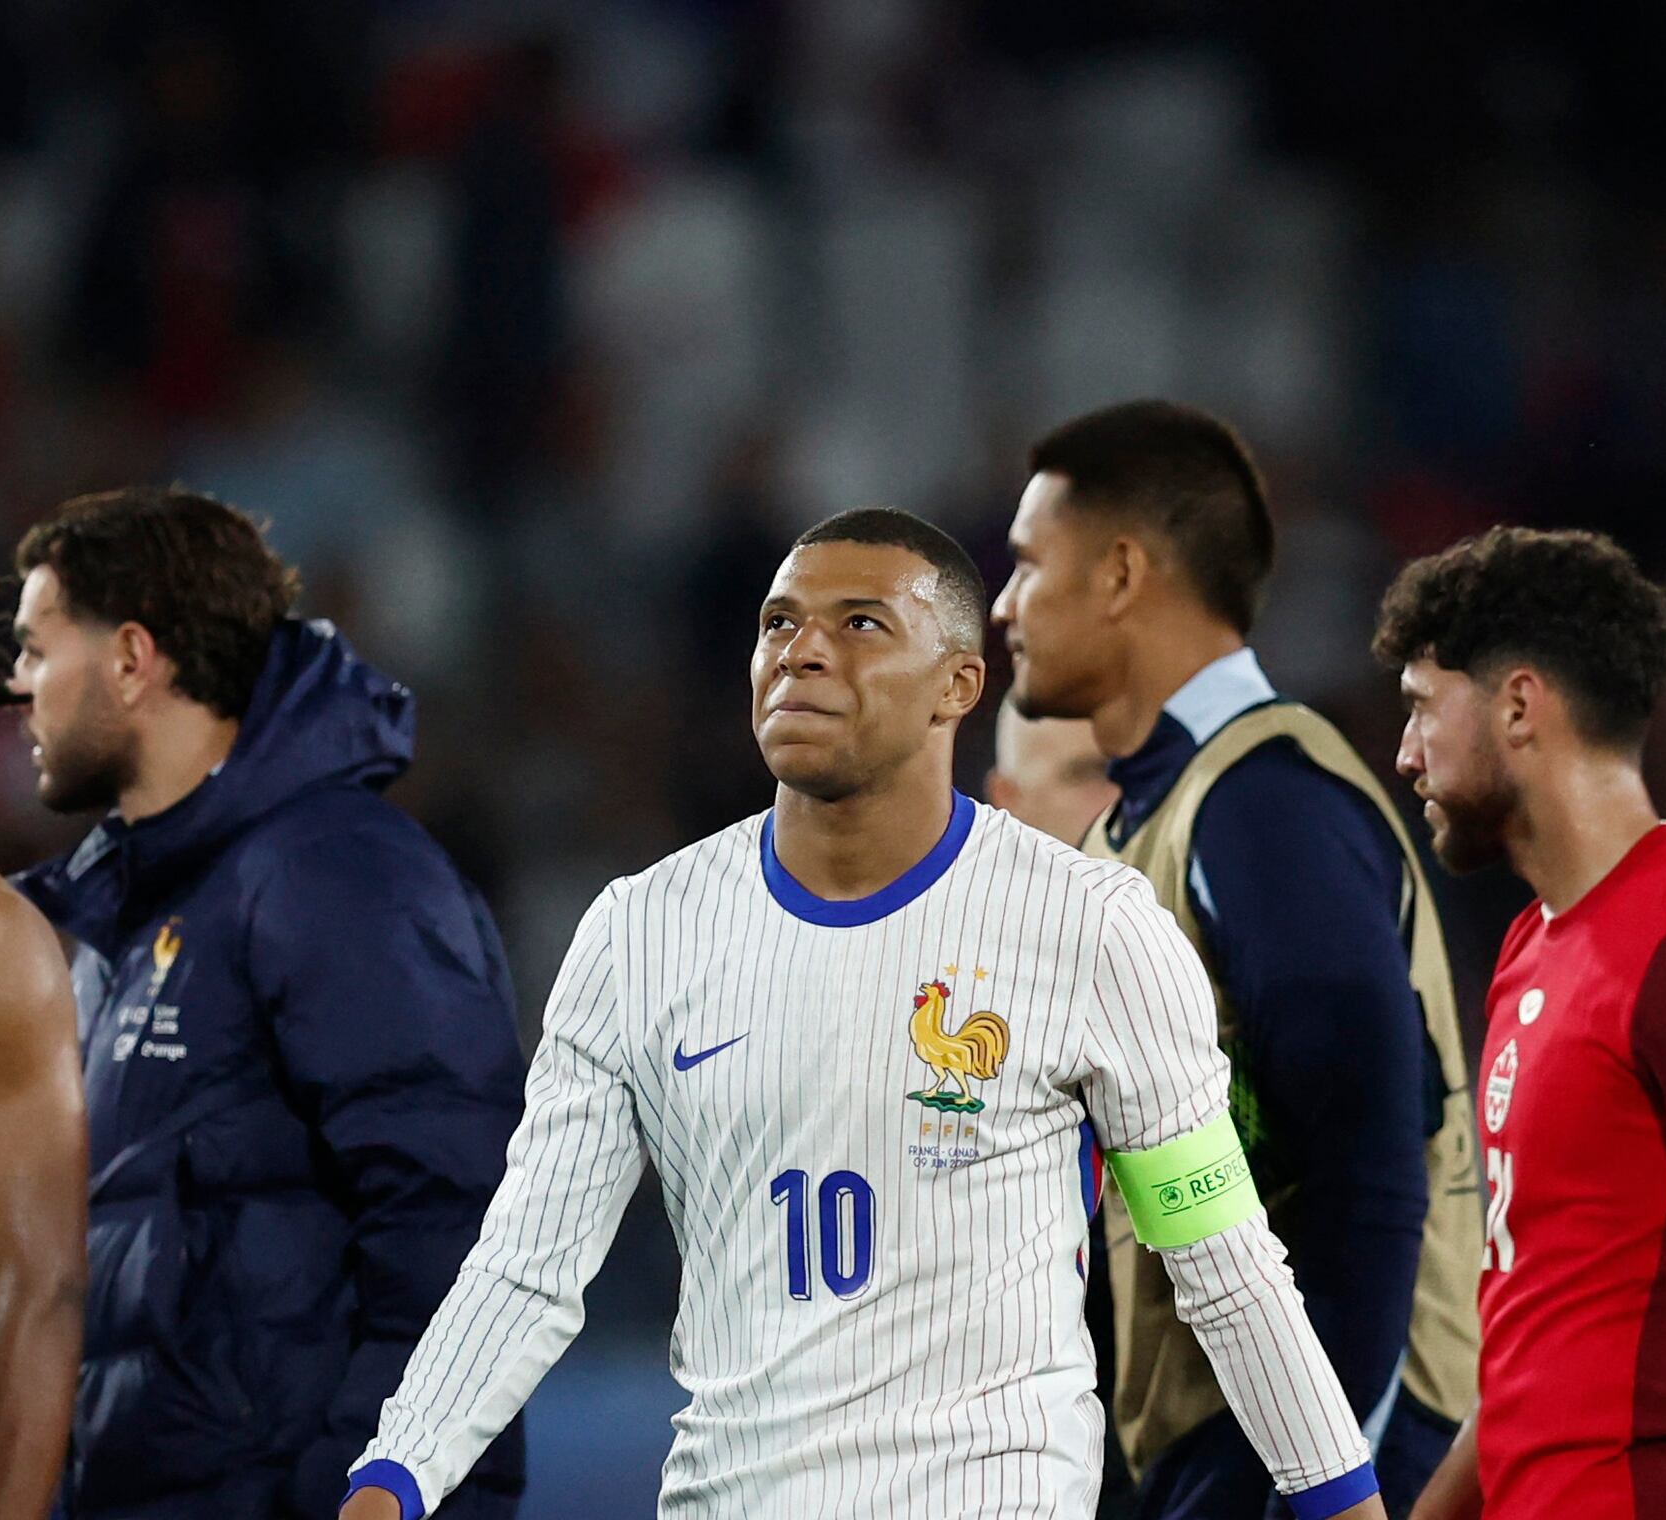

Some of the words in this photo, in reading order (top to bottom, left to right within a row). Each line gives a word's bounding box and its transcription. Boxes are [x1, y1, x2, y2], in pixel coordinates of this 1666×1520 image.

[908, 1145, 939, 1156] FRANCE
[948, 1147, 980, 1158] CANADA
[913, 1157, 927, 1167] 09
[931, 1158, 947, 1168] JUN
[770, 1169, 876, 1301] 10
